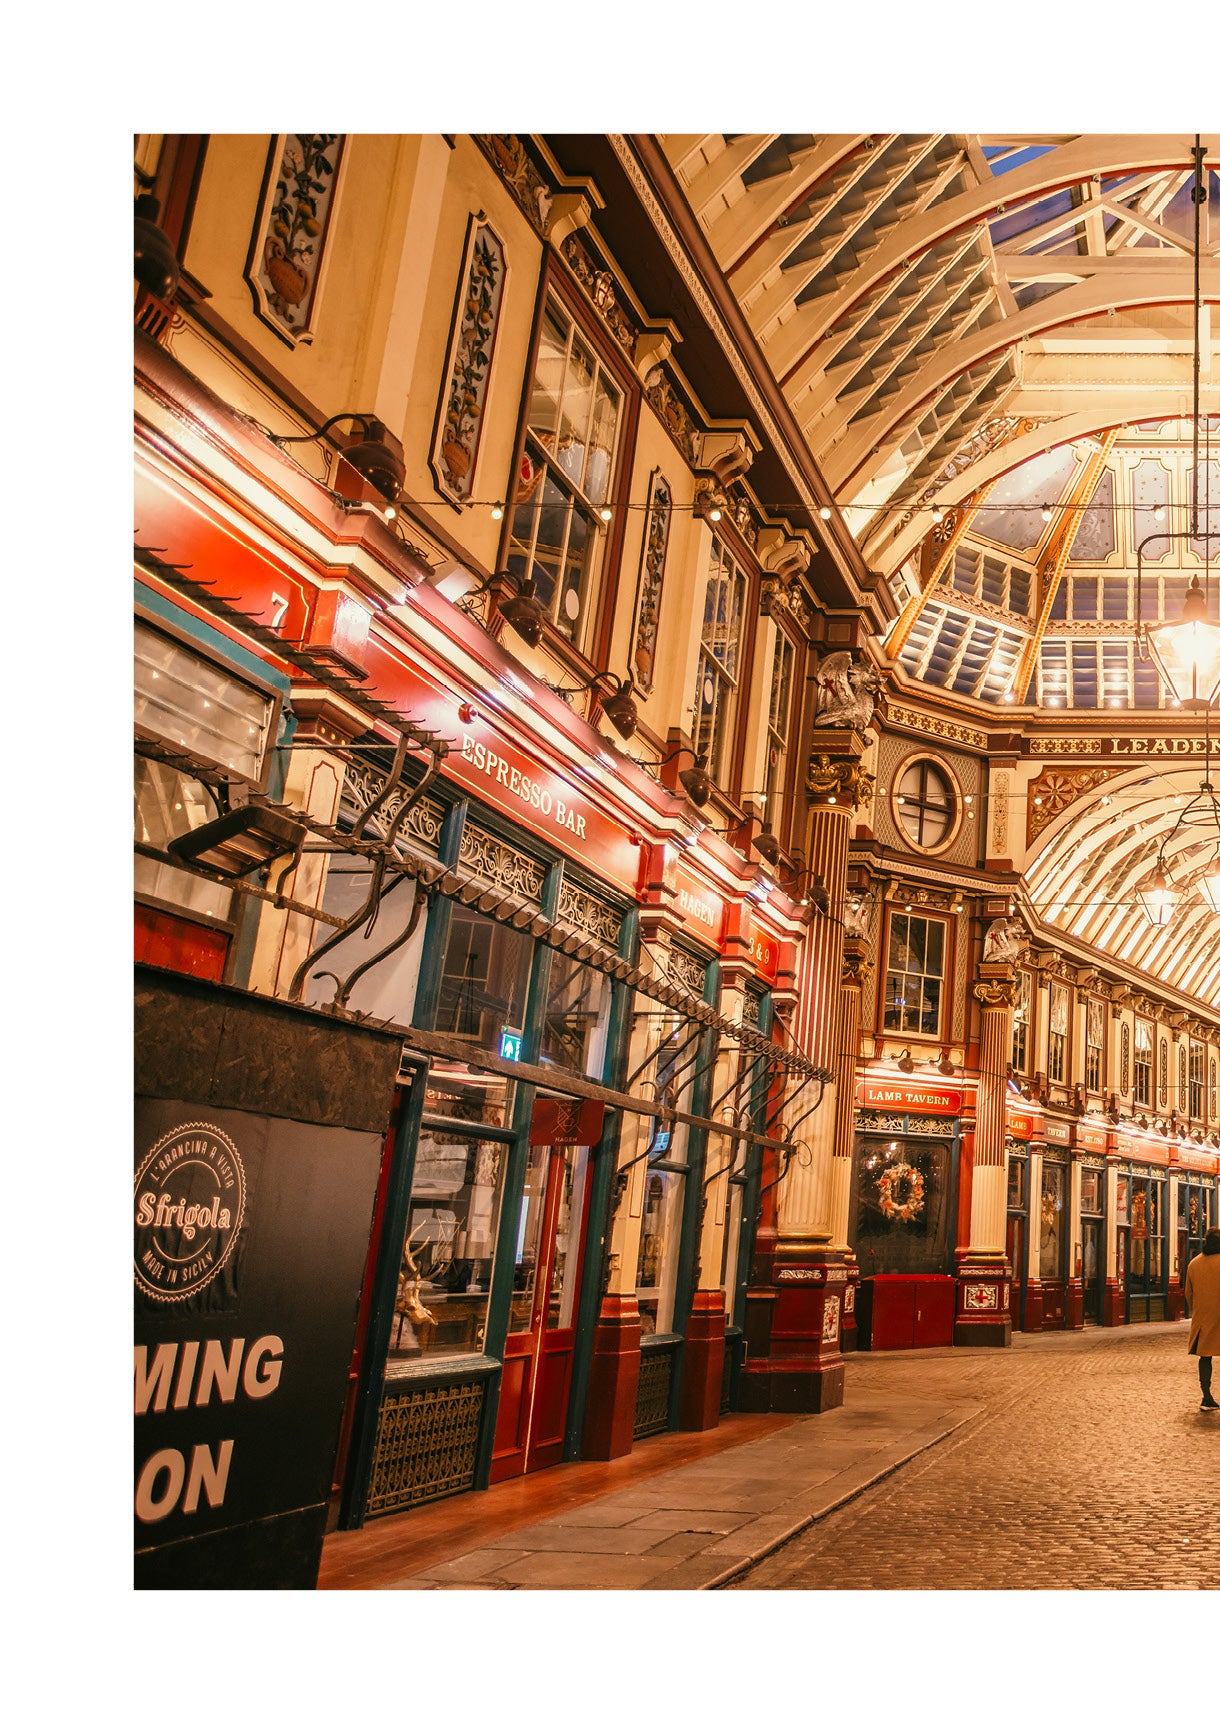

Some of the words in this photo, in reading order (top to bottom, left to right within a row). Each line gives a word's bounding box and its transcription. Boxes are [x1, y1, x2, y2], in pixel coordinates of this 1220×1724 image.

[271, 591, 289, 631] 7
[461, 732, 552, 816] ESPRESSO
[555, 799, 586, 840] BAR
[680, 888, 715, 928] HAGEN
[868, 1090, 902, 1101] LAMB
[905, 1093, 950, 1105] TAVERN
[150, 1140, 208, 1182] L'ARANCINA
[209, 1146, 218, 1159] A
[216, 1153, 235, 1189] VISTA
[136, 1192, 231, 1240] Sfrigola
[142, 1249, 165, 1280] MADE
[166, 1268, 178, 1284] IN
[182, 1250, 214, 1283] SICILY
[134, 1439, 235, 1525] ON
